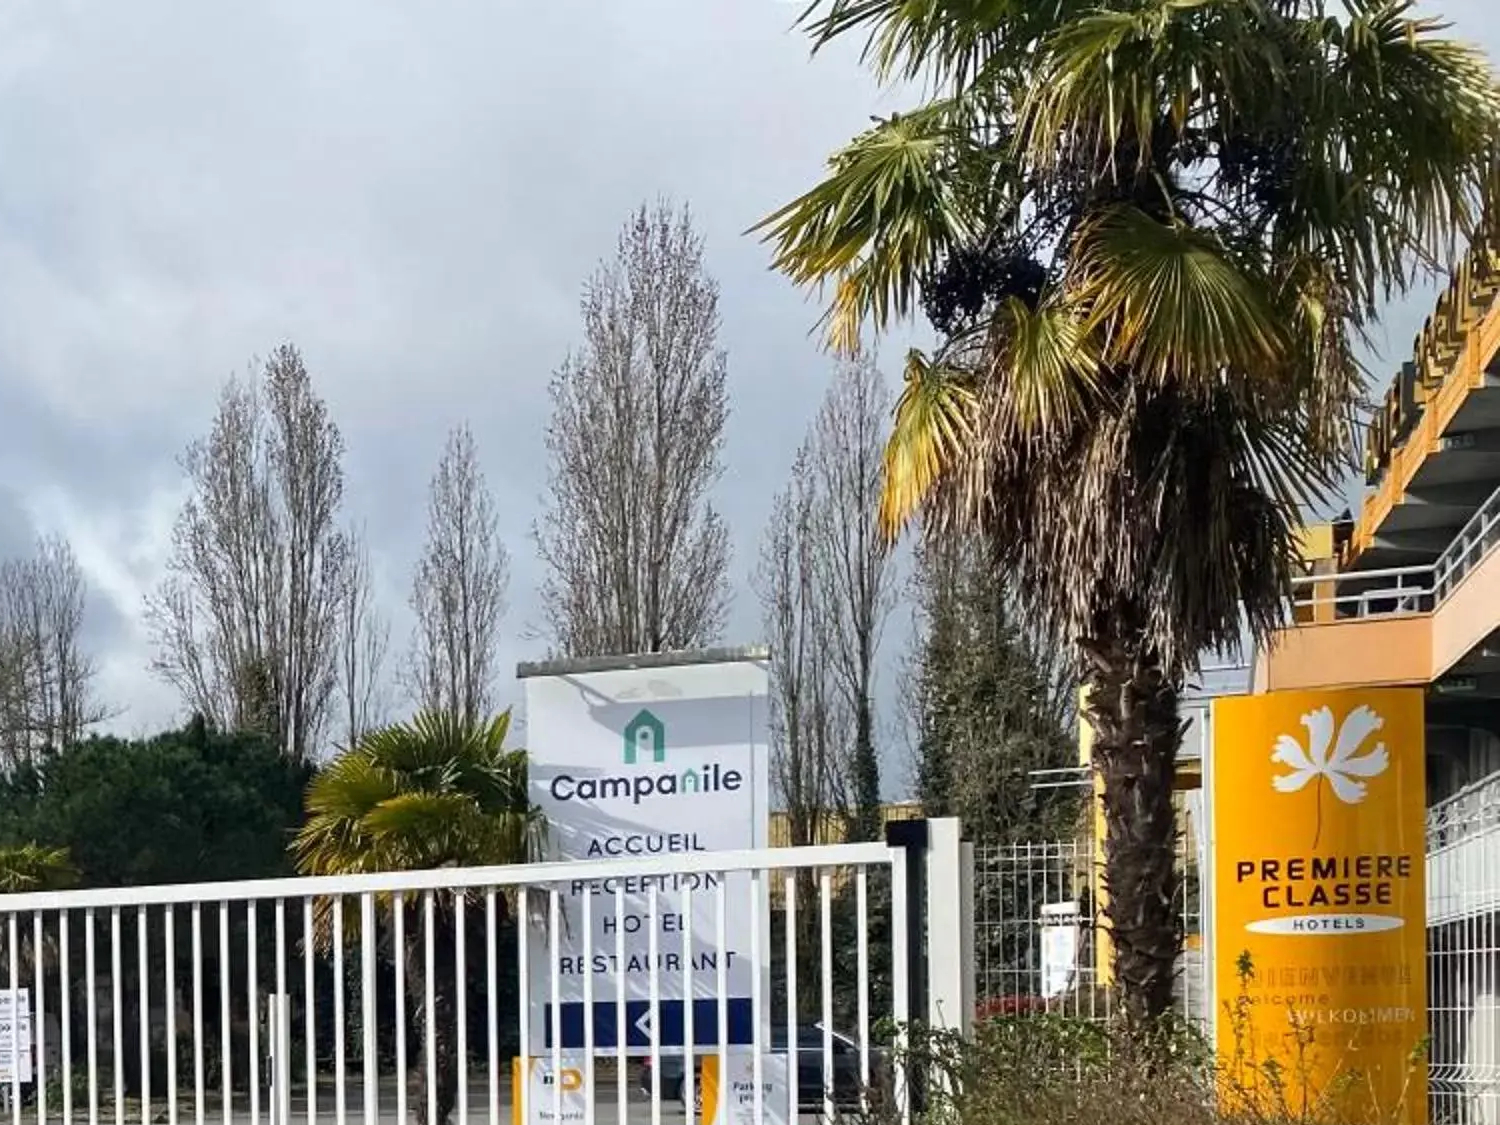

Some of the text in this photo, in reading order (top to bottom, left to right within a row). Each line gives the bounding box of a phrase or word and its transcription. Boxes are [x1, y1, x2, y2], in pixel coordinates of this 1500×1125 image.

[551, 764, 742, 804] Campanile
[588, 833, 706, 856] ACCUEIL
[1238, 856, 1410, 882] PREMIERE
[1264, 884, 1391, 907] CLASSE
[1293, 918, 1365, 930] HOTELS
